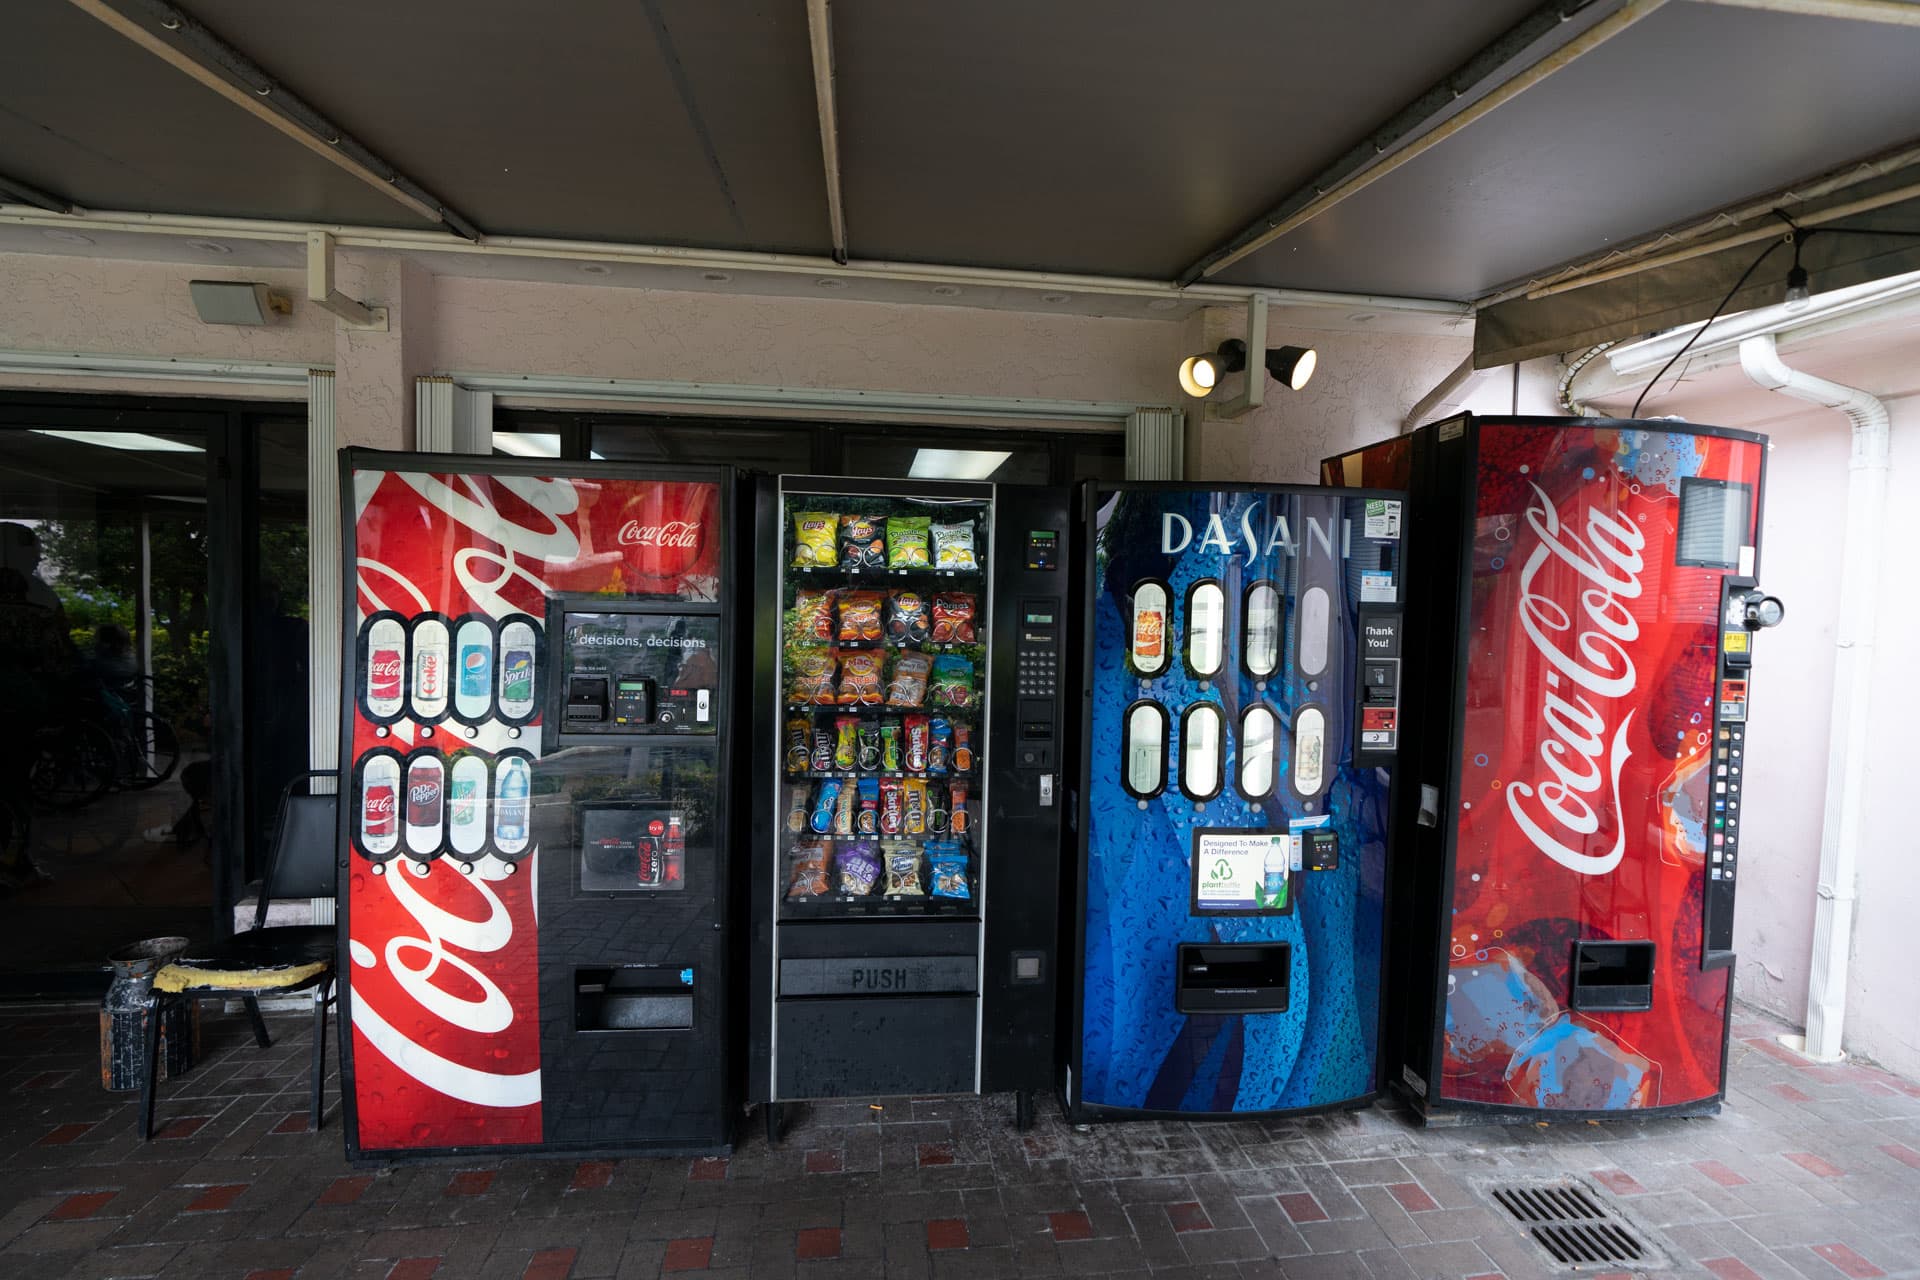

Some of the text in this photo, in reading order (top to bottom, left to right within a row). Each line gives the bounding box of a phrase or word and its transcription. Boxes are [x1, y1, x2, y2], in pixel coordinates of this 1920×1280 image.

[617, 519, 701, 548] Coca-Cola
[1161, 501, 1351, 567] DASANI
[1365, 626, 1394, 636] Thank
[579, 634, 706, 648] decisions, decisions
[1368, 639, 1389, 648] You!
[422, 655, 437, 694] Coke
[1506, 480, 1645, 875] Coca-Cola
[911, 727, 923, 768] Skittles
[411, 786, 438, 803] Pepper
[420, 784, 432, 792] Dr
[886, 791, 898, 828] Skittles
[1203, 839, 1237, 849] Designed
[1211, 848, 1249, 856] Difference
[852, 969, 907, 989] PUSH
